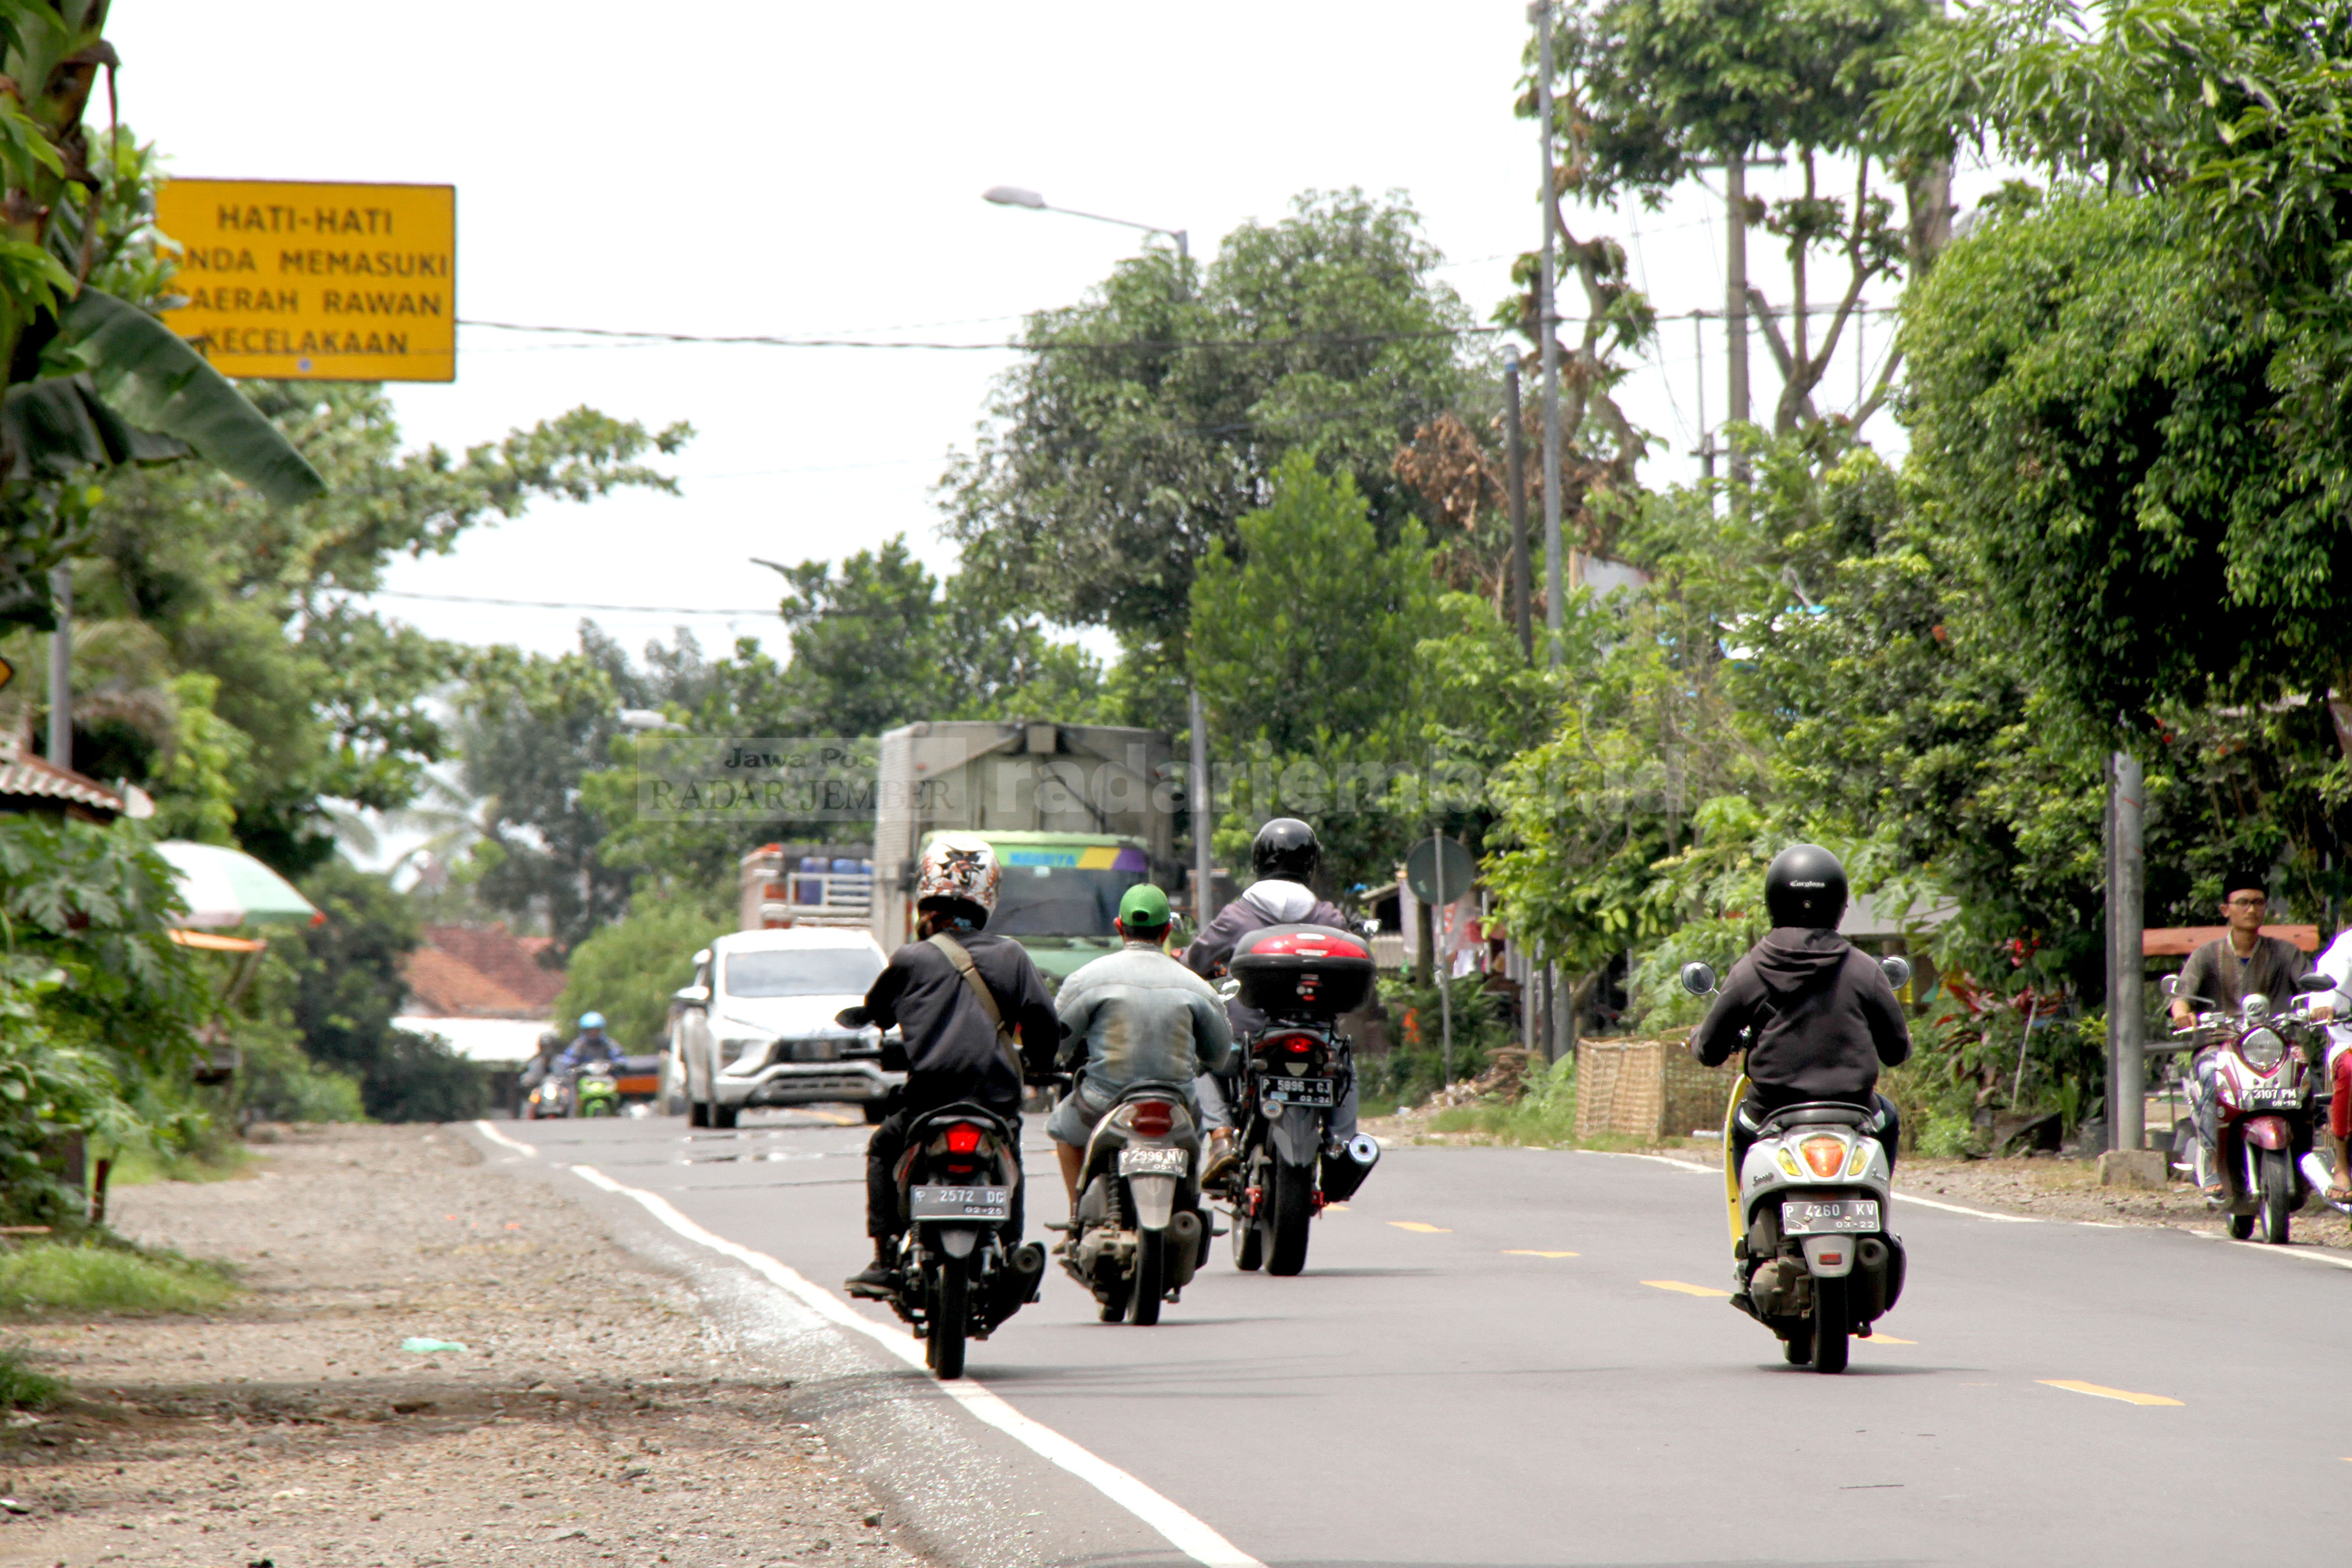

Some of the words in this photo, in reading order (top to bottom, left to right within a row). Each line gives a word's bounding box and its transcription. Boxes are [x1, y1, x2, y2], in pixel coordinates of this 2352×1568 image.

[217, 204, 393, 235] HATI-HATI
[279, 250, 447, 279] MEMASUKI
[324, 289, 442, 316] RAWAN
[201, 327, 408, 355] KECELAKAAN
[1263, 1078, 1270, 1089] P
[2254, 1089, 2278, 1099] 3107
[940, 1190, 975, 1202] 2572
[1786, 1205, 1793, 1218] P
[1805, 1204, 1840, 1217] 4260
[1856, 1204, 1874, 1215] KV
